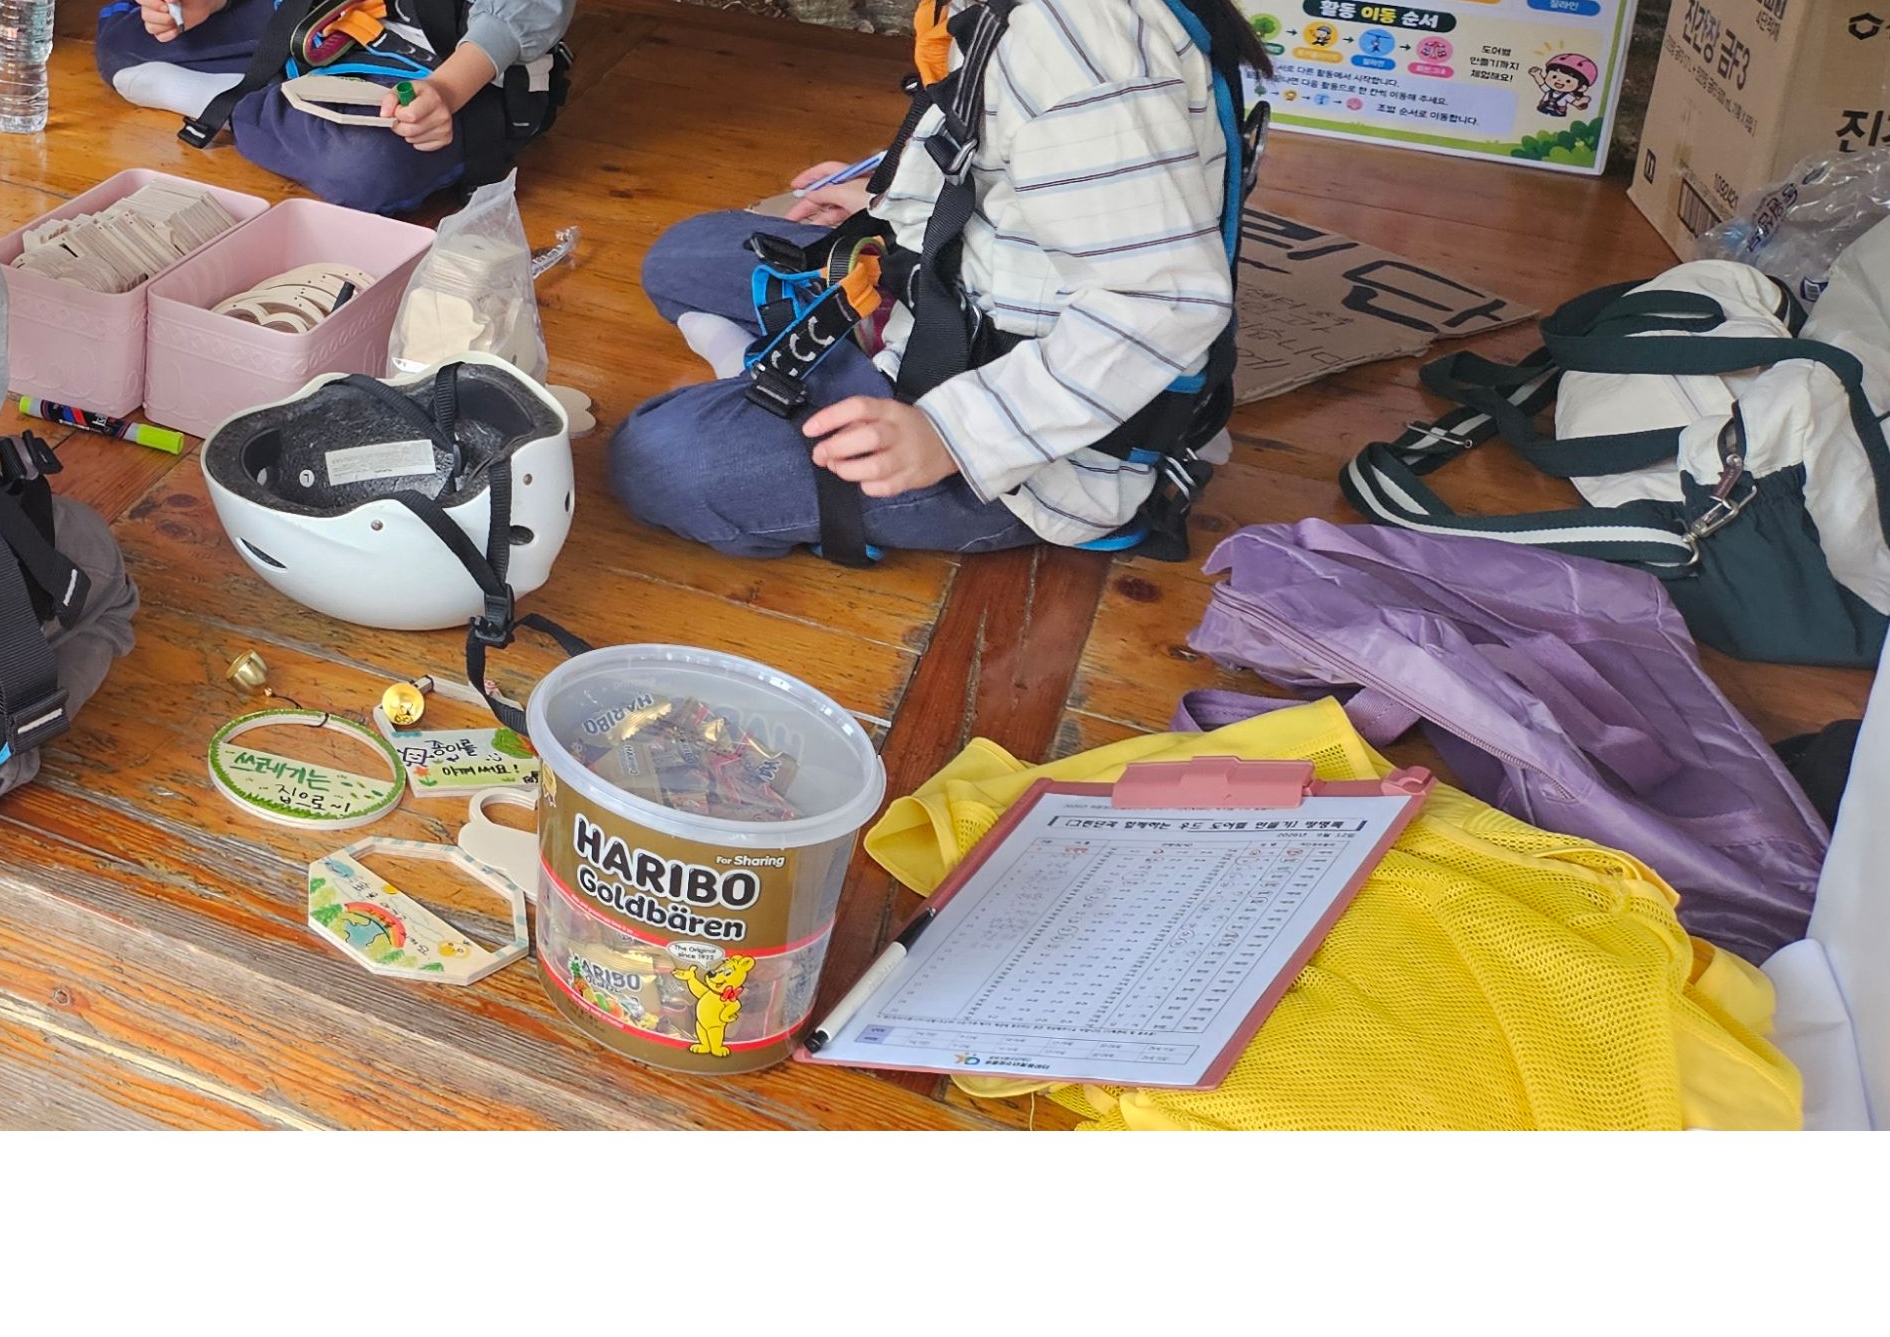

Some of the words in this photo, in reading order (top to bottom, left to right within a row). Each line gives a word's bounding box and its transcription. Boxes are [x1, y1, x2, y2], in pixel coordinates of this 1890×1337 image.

[1320, 0, 1356, 19] 활동
[1361, 6, 1397, 24] 이동
[1401, 11, 1439, 29] 순서
[1481, 45, 1512, 57] 도어벨
[1470, 56, 1520, 71] 만들기까지
[1277, 64, 1294, 73] 서로
[1297, 65, 1314, 75] 다른
[1316, 69, 1351, 81] 활동에서
[1353, 74, 1400, 88] 시작합니다.
[1471, 69, 1513, 83] 체험해요!
[1301, 79, 1318, 89] 다음
[1321, 81, 1356, 93] 활동으로
[1359, 86, 1367, 95] 한
[1389, 90, 1417, 102] 이동해
[1419, 94, 1449, 106] 주세요.
[1376, 103, 1396, 114] 조별
[1399, 107, 1428, 119] 순서로
[1430, 111, 1480, 126] 이동합니다.
[424, 739, 478, 758] 종이를
[575, 815, 758, 908] HARIBO
[716, 856, 731, 865] For
[734, 855, 785, 867] Sharing
[579, 866, 745, 939] Goldbären
[678, 952, 695, 960] since
[689, 946, 716, 955] Original
